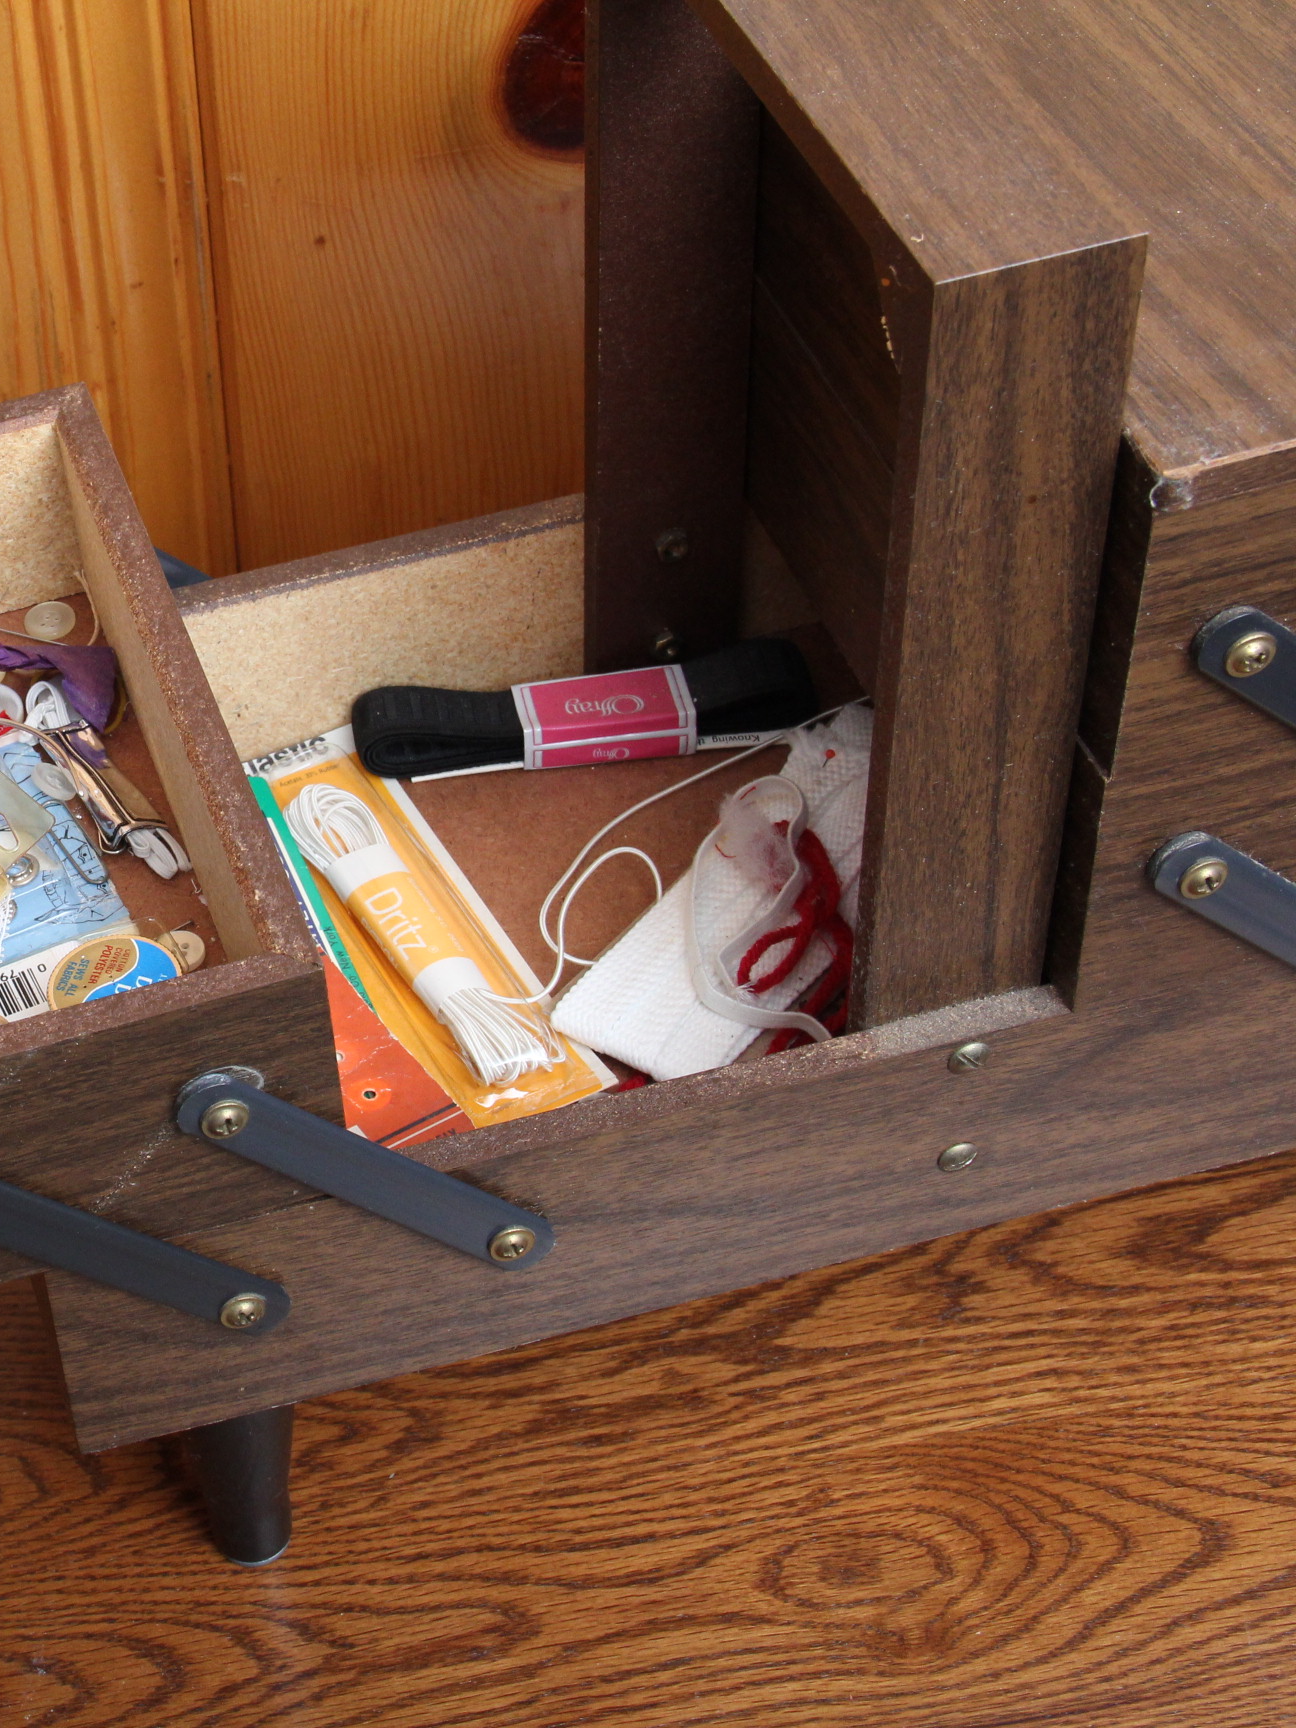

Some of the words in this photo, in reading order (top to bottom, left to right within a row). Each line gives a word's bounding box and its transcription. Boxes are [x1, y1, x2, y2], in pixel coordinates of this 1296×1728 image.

[711, 734, 761, 744] Knowing
[323, 926, 338, 948] York
[37, 963, 47, 973] 0
[73, 958, 90, 980] SEWS
[87, 944, 114, 985] POLYESTER
[104, 947, 123, 975] COVERED
[116, 949, 131, 973] COTTON
[336, 950, 351, 971] New
[56, 961, 78, 992] FABRICS
[64, 984, 79, 997] ALL
